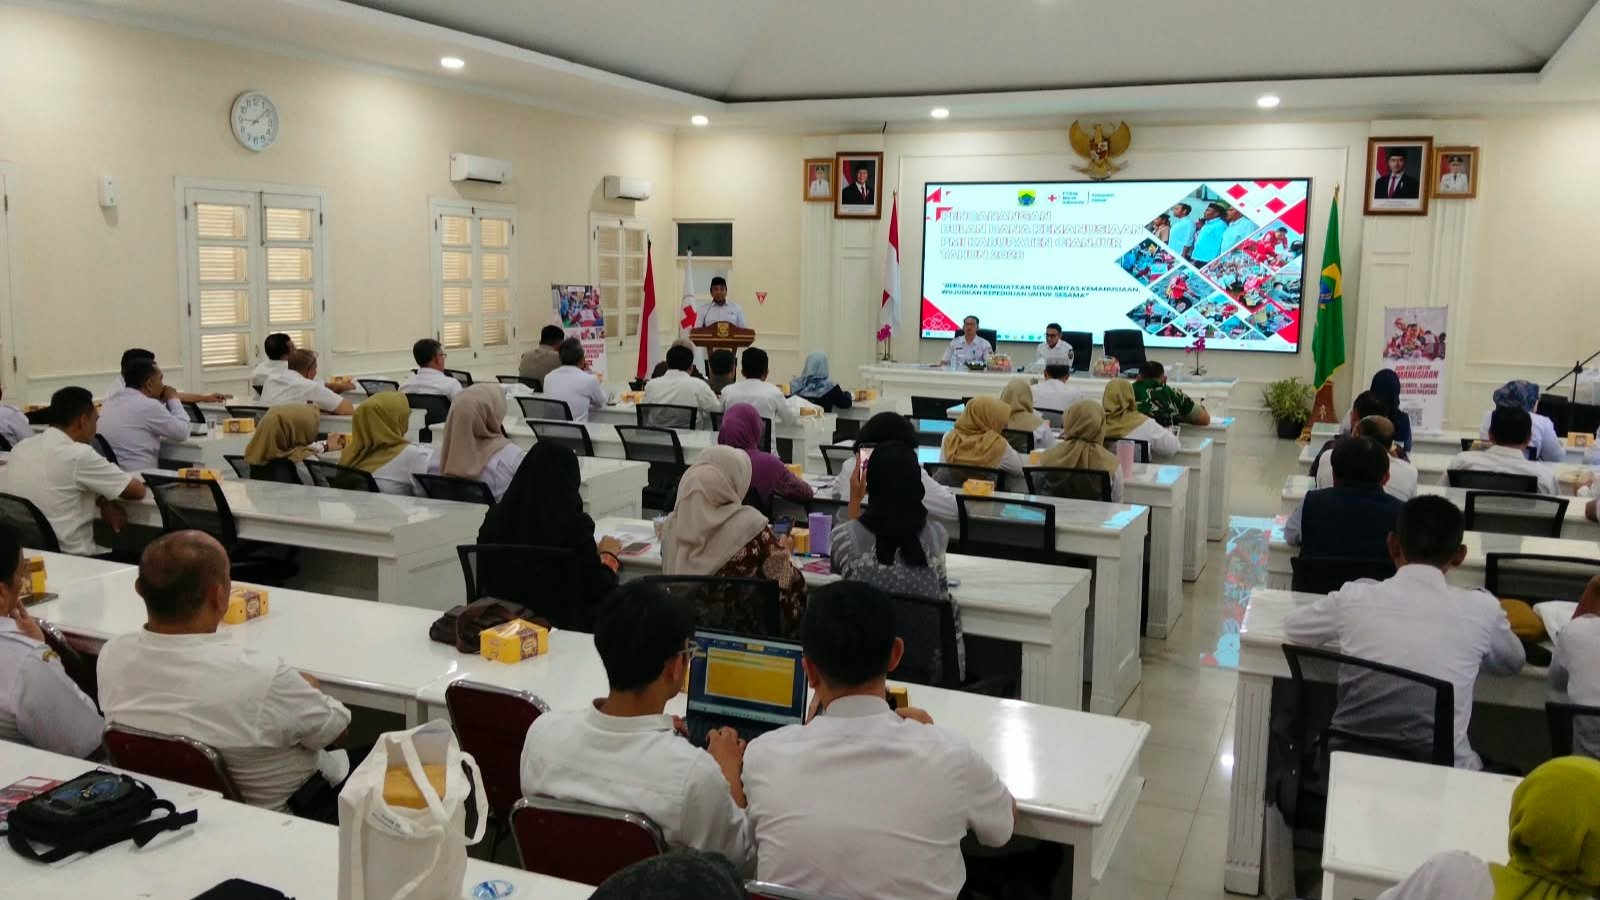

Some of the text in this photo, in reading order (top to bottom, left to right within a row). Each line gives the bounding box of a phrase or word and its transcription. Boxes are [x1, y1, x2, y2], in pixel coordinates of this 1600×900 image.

[941, 211, 1052, 221] PENCANANGAN
[940, 223, 1144, 234] BULAN DANA KEMANUSIAAN
[940, 237, 1122, 248] PMI KABUPATEN CIANJUR
[939, 249, 989, 260] TAHUN
